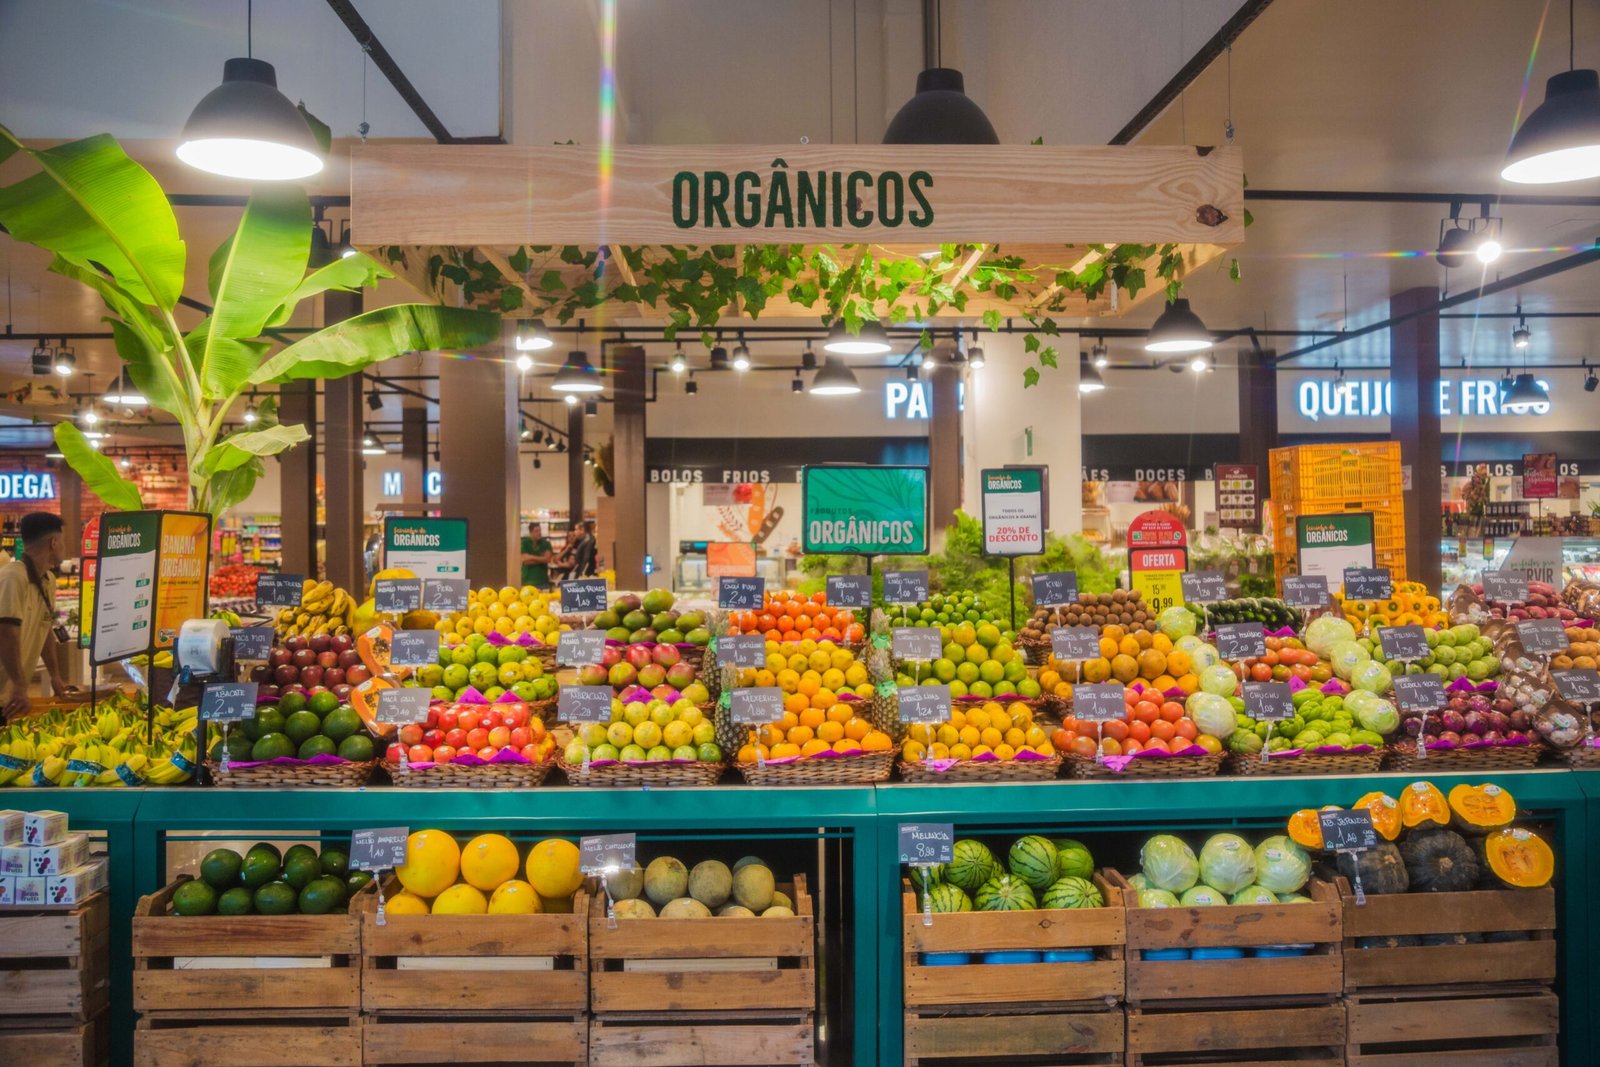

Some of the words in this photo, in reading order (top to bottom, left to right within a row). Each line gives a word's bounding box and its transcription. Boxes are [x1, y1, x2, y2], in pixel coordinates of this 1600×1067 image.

[672, 158, 934, 229] ORGÂNICOS
[1299, 380, 1391, 422] QUEIJ
[651, 469, 703, 483] BOLOS
[723, 470, 770, 483] FRIOS
[1135, 469, 1186, 481] DOCES
[987, 479, 1022, 490] ORGÂNICOS
[809, 517, 914, 545] ORGÂNICOS
[988, 533, 1038, 543] DESCONTO
[997, 526, 1016, 535] 20%
[1018, 526, 1030, 534] DE
[1306, 528, 1348, 544] ORGÂNICOS
[107, 531, 142, 550] ORGÂNICOS
[162, 534, 196, 555] BANANA
[393, 531, 440, 547] ORGÂNICOS
[160, 553, 201, 578] ORGÂNICA
[1142, 553, 1176, 567] OFERTA
[1250, 692, 1280, 700] CHUCHU
